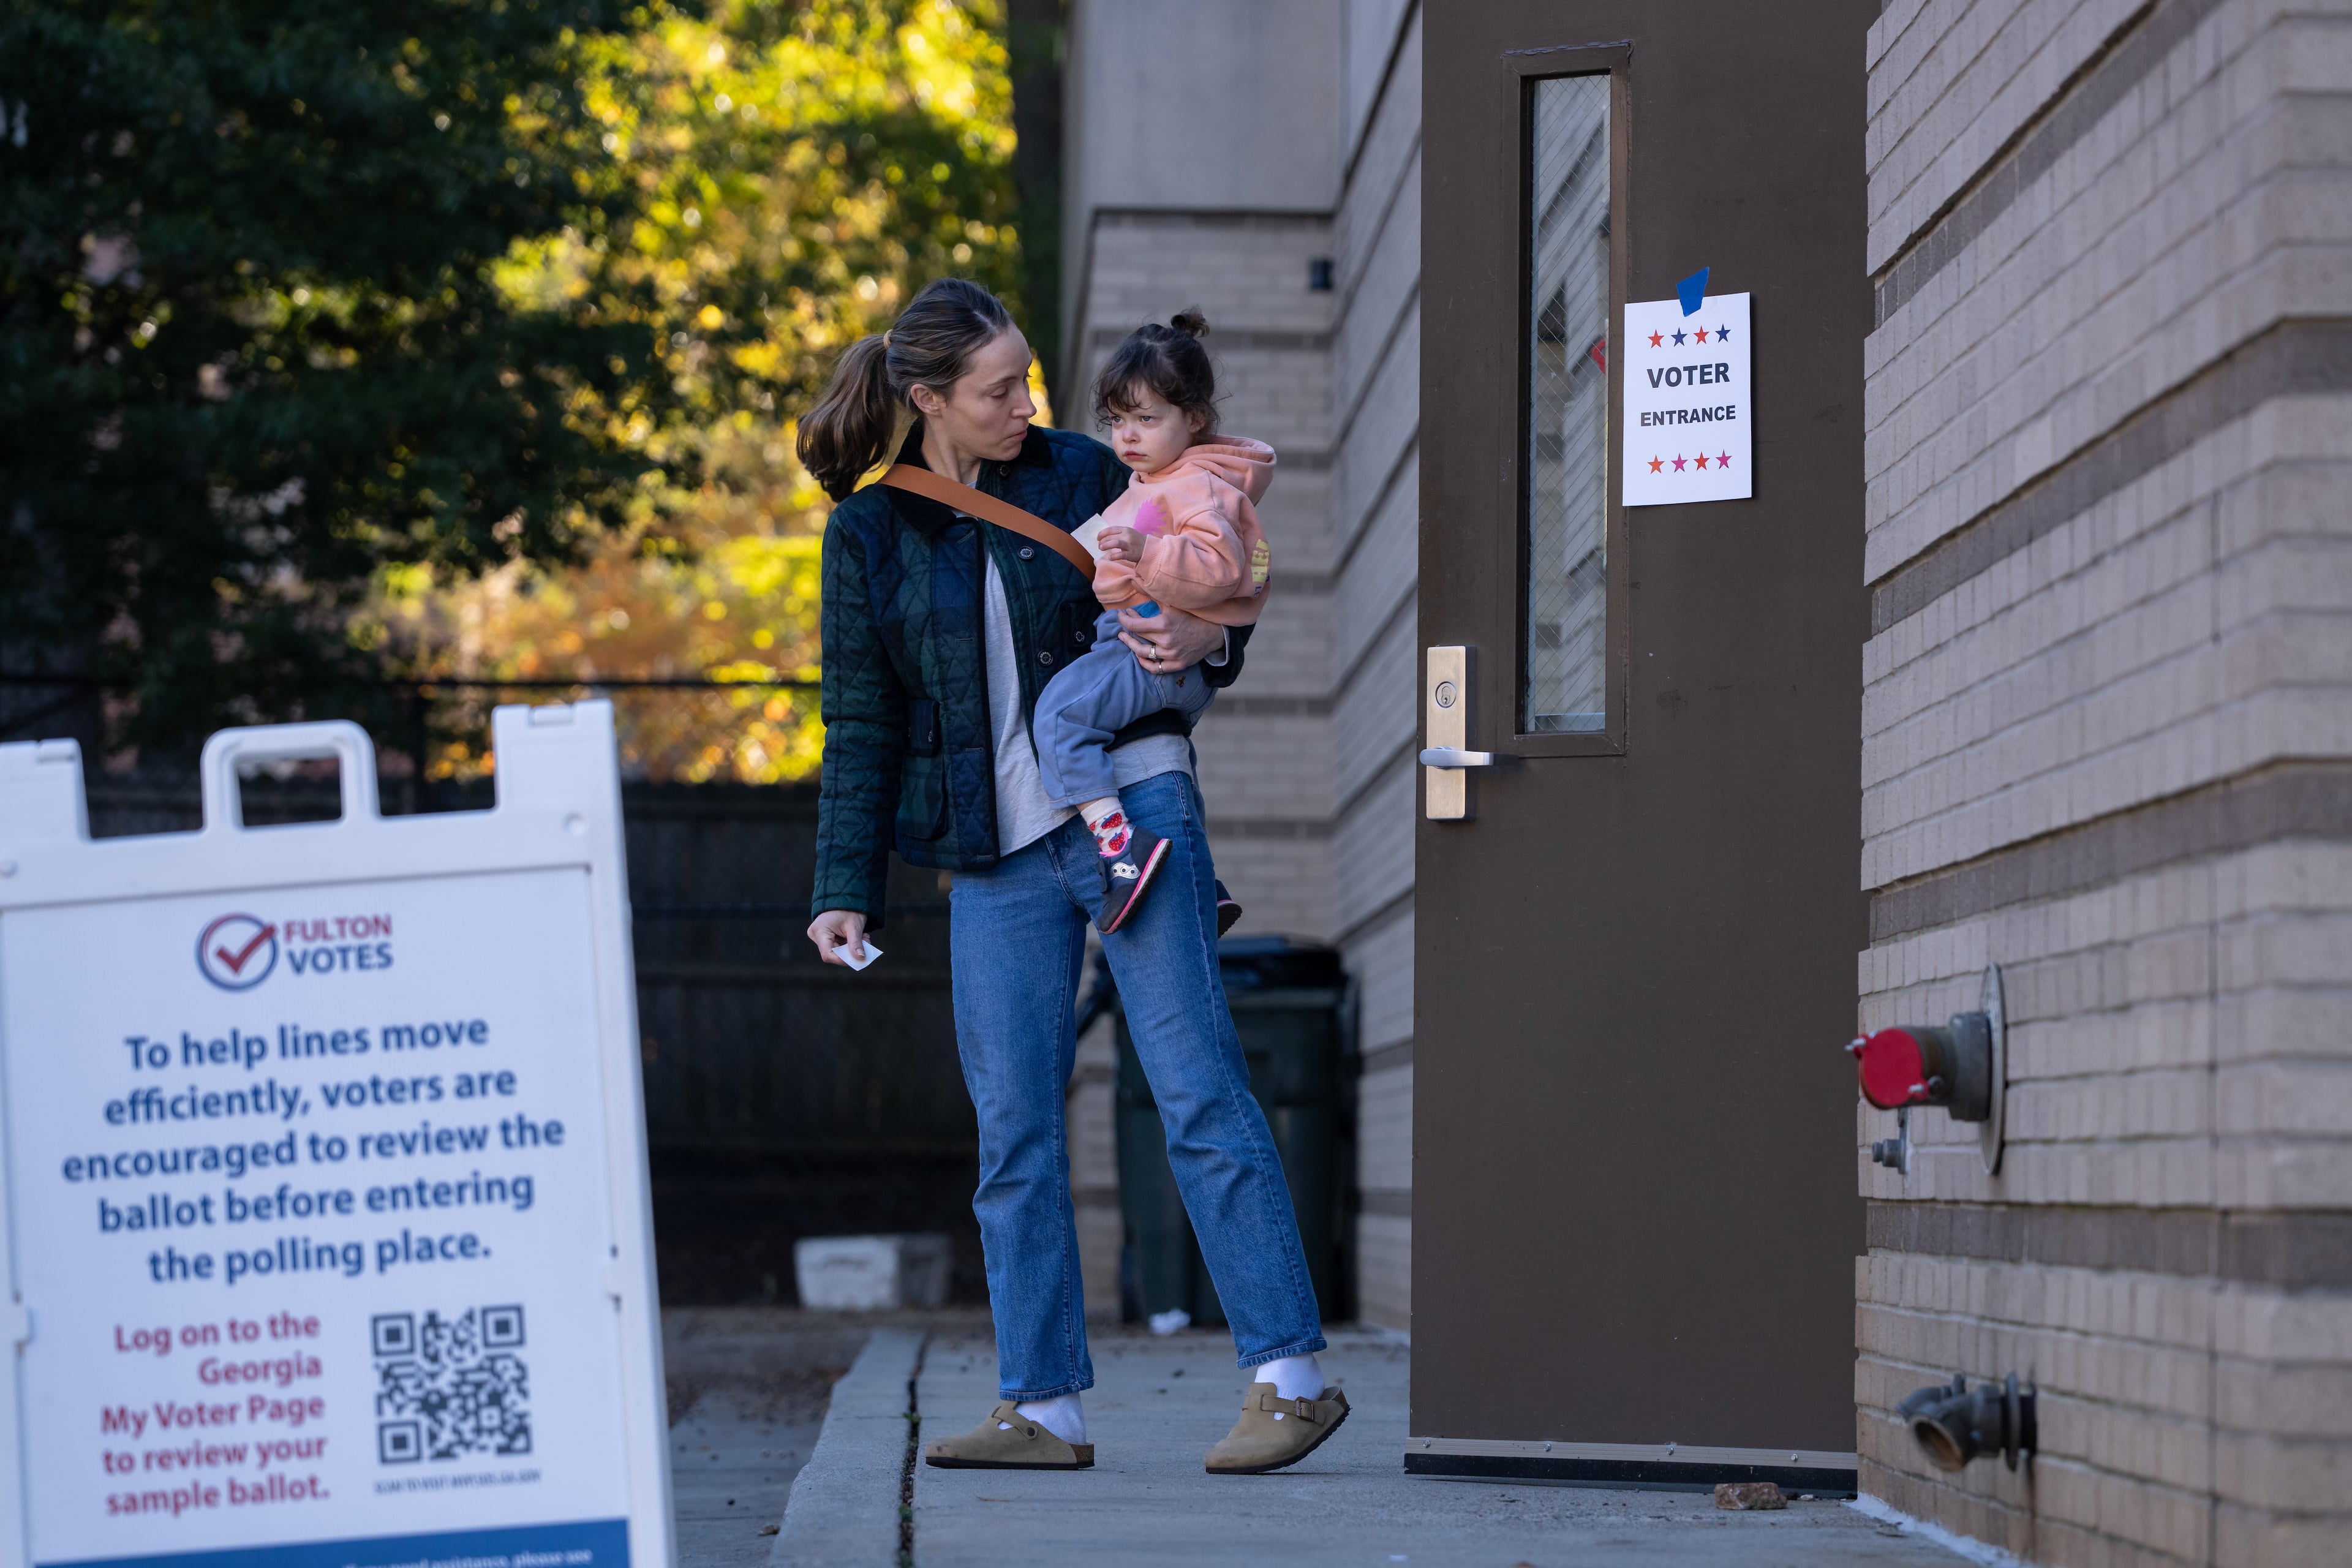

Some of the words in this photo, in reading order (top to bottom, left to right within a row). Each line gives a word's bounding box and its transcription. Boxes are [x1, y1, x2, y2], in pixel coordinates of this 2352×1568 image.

[1646, 363, 1730, 388] VOTER
[1641, 405, 1736, 426] ENTRANCE
[284, 914, 392, 944] FULTON
[287, 942, 394, 975] VOTES
[124, 1036, 171, 1070] To
[181, 1028, 268, 1071] help
[278, 1024, 371, 1059] lines
[381, 1019, 489, 1051] move
[104, 1078, 311, 1126] efficiently,
[320, 1075, 444, 1109] voters
[454, 1071, 516, 1099] are
[62, 1130, 298, 1183] encouraged
[307, 1133, 348, 1163] to
[358, 1121, 489, 1159] review
[499, 1114, 564, 1149] the
[99, 1193, 214, 1233] ballot
[225, 1183, 355, 1223] before
[365, 1170, 534, 1212] entering
[148, 1246, 214, 1283] the
[225, 1237, 364, 1286] polling
[375, 1229, 491, 1275] place.
[115, 1325, 172, 1357] Log
[179, 1324, 220, 1347] on
[227, 1319, 260, 1343] to
[268, 1311, 320, 1340] the
[198, 1351, 322, 1388] Georgia
[102, 1406, 148, 1439] My
[154, 1401, 240, 1430] Voter
[247, 1395, 325, 1427] Page
[103, 1450, 135, 1475] to
[143, 1440, 248, 1471] review
[255, 1438, 327, 1470] your
[107, 1480, 221, 1517] sample
[228, 1474, 330, 1506] ballot.
